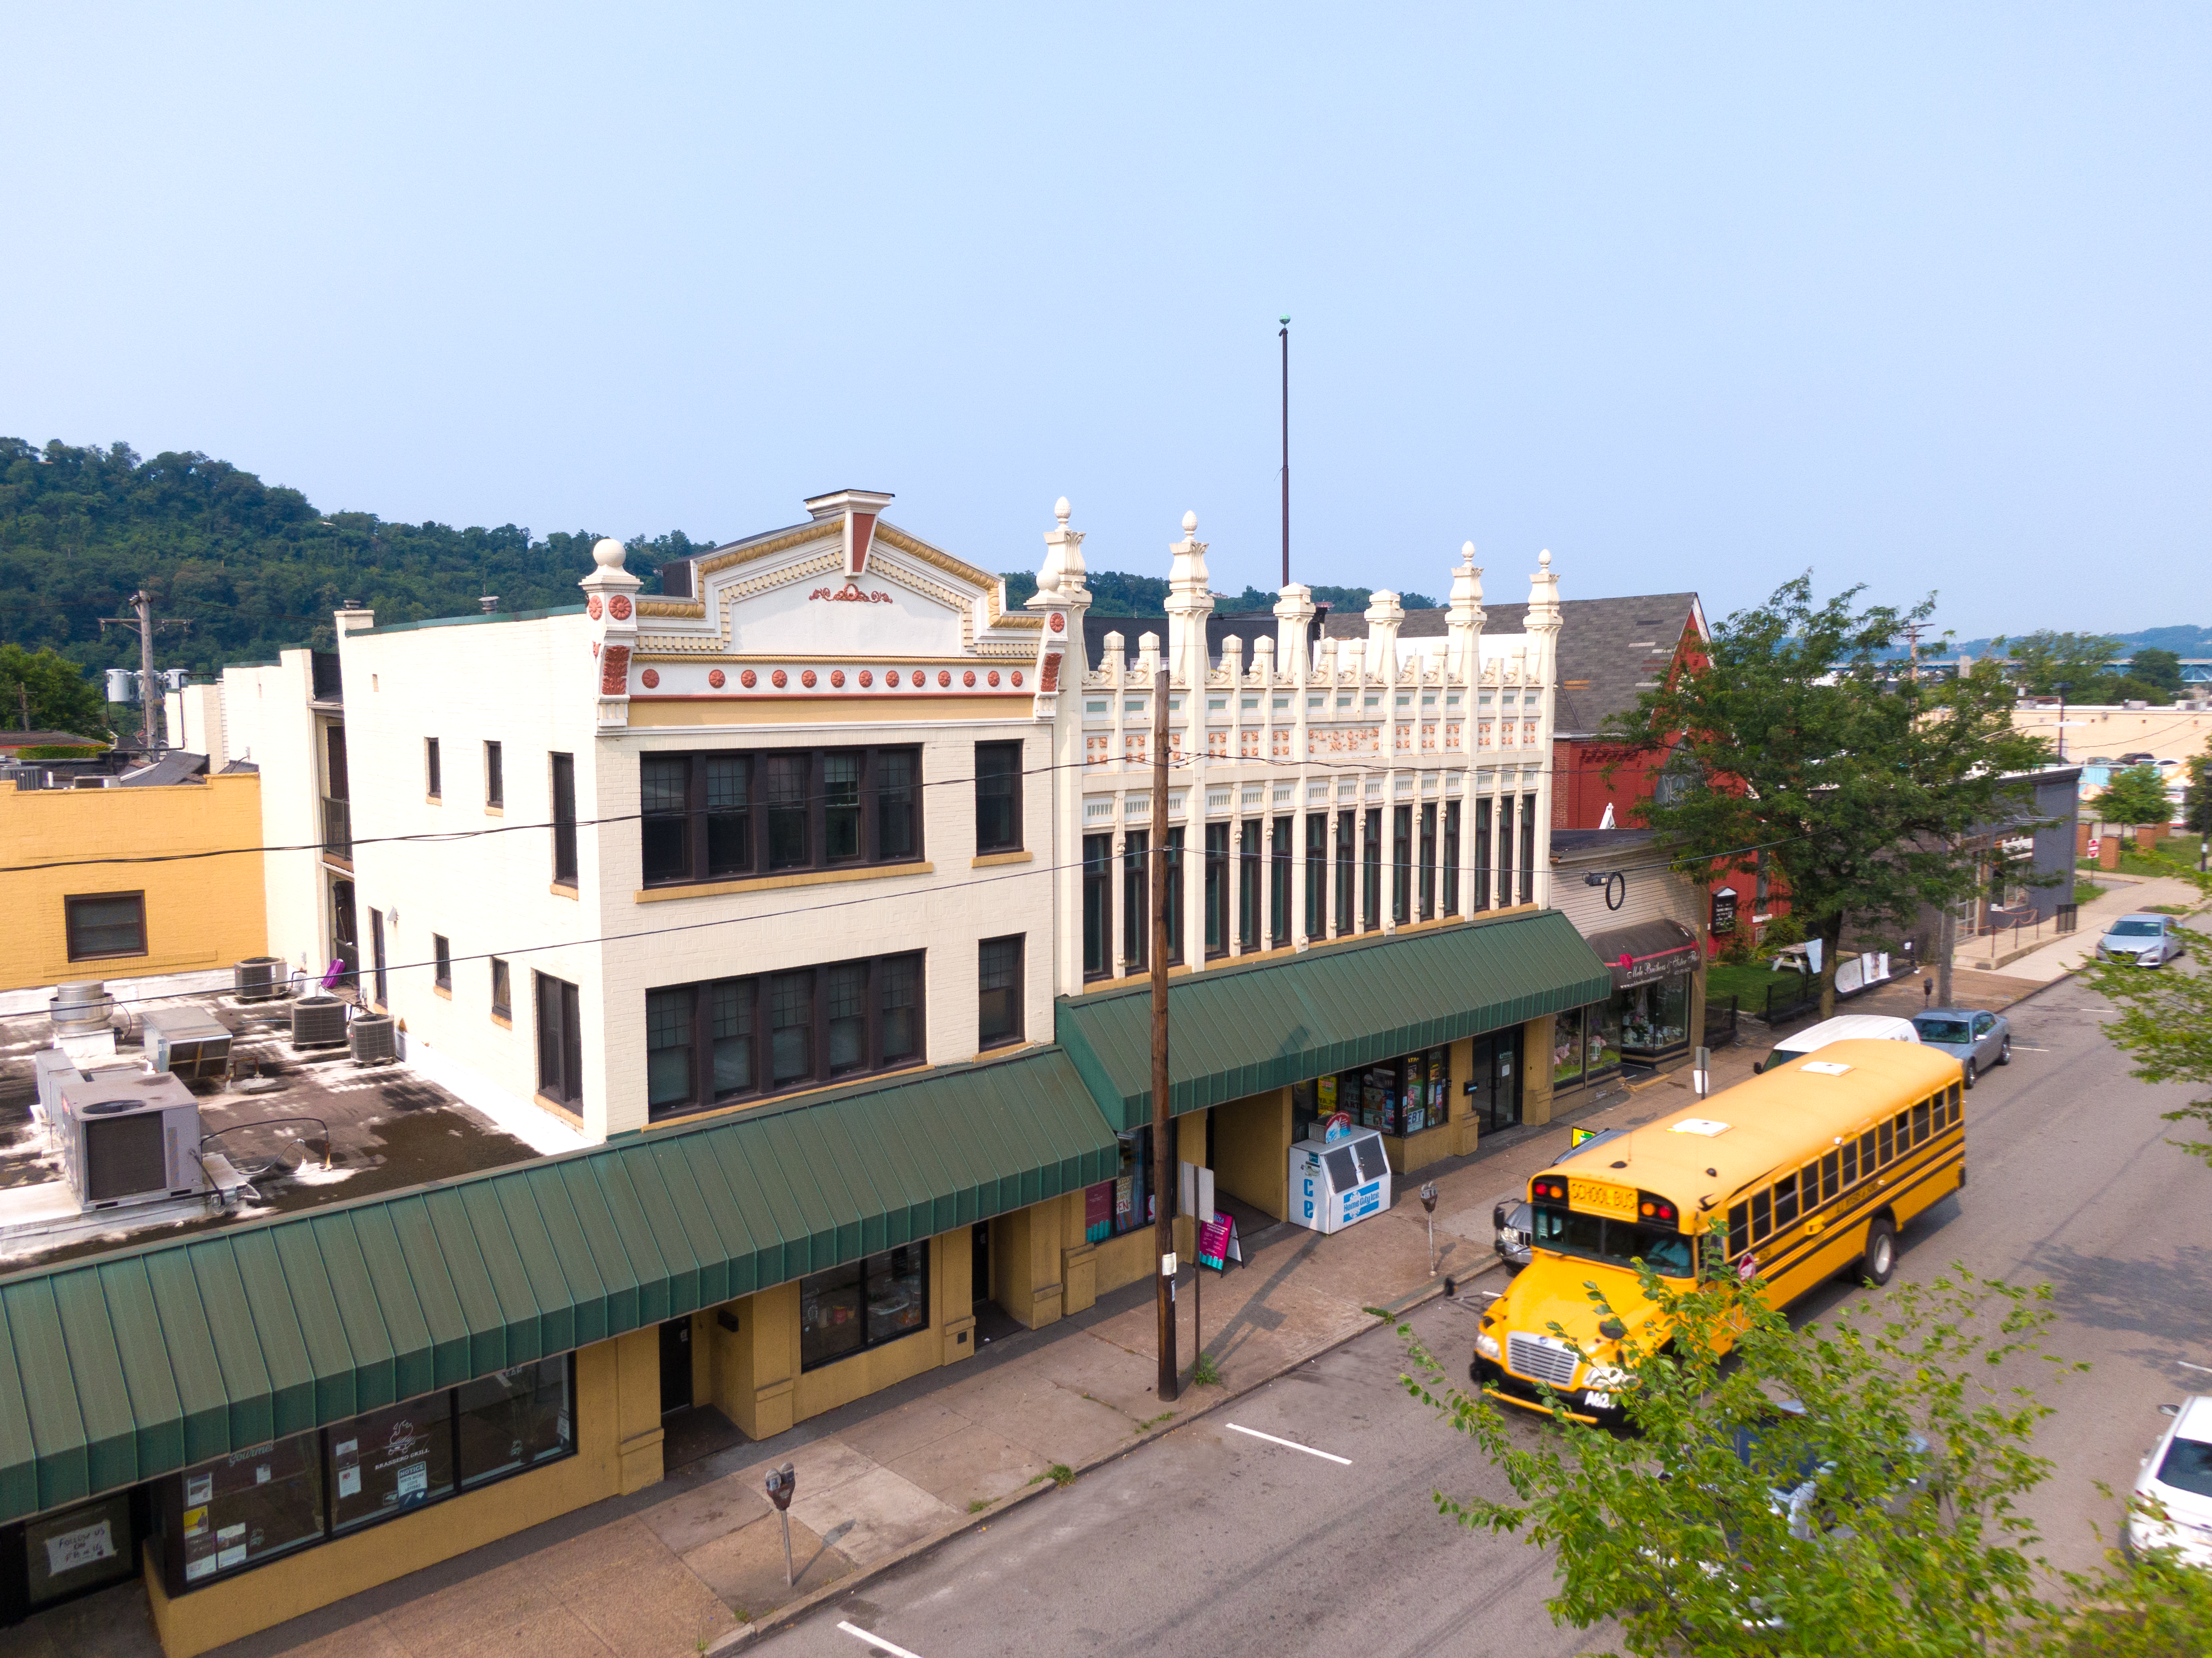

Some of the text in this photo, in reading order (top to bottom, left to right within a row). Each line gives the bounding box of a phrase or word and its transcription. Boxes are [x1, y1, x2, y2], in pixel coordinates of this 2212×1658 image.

[1407, 1109, 1423, 1125] EBT
[1344, 1192, 1379, 1212] Home City Ice
[1571, 1184, 1636, 1209] SCHOOL BUS
[1584, 1390, 1616, 1409] A62
[411, 1448, 430, 1459] GRILL
[400, 1463, 425, 1477] NOTICE
